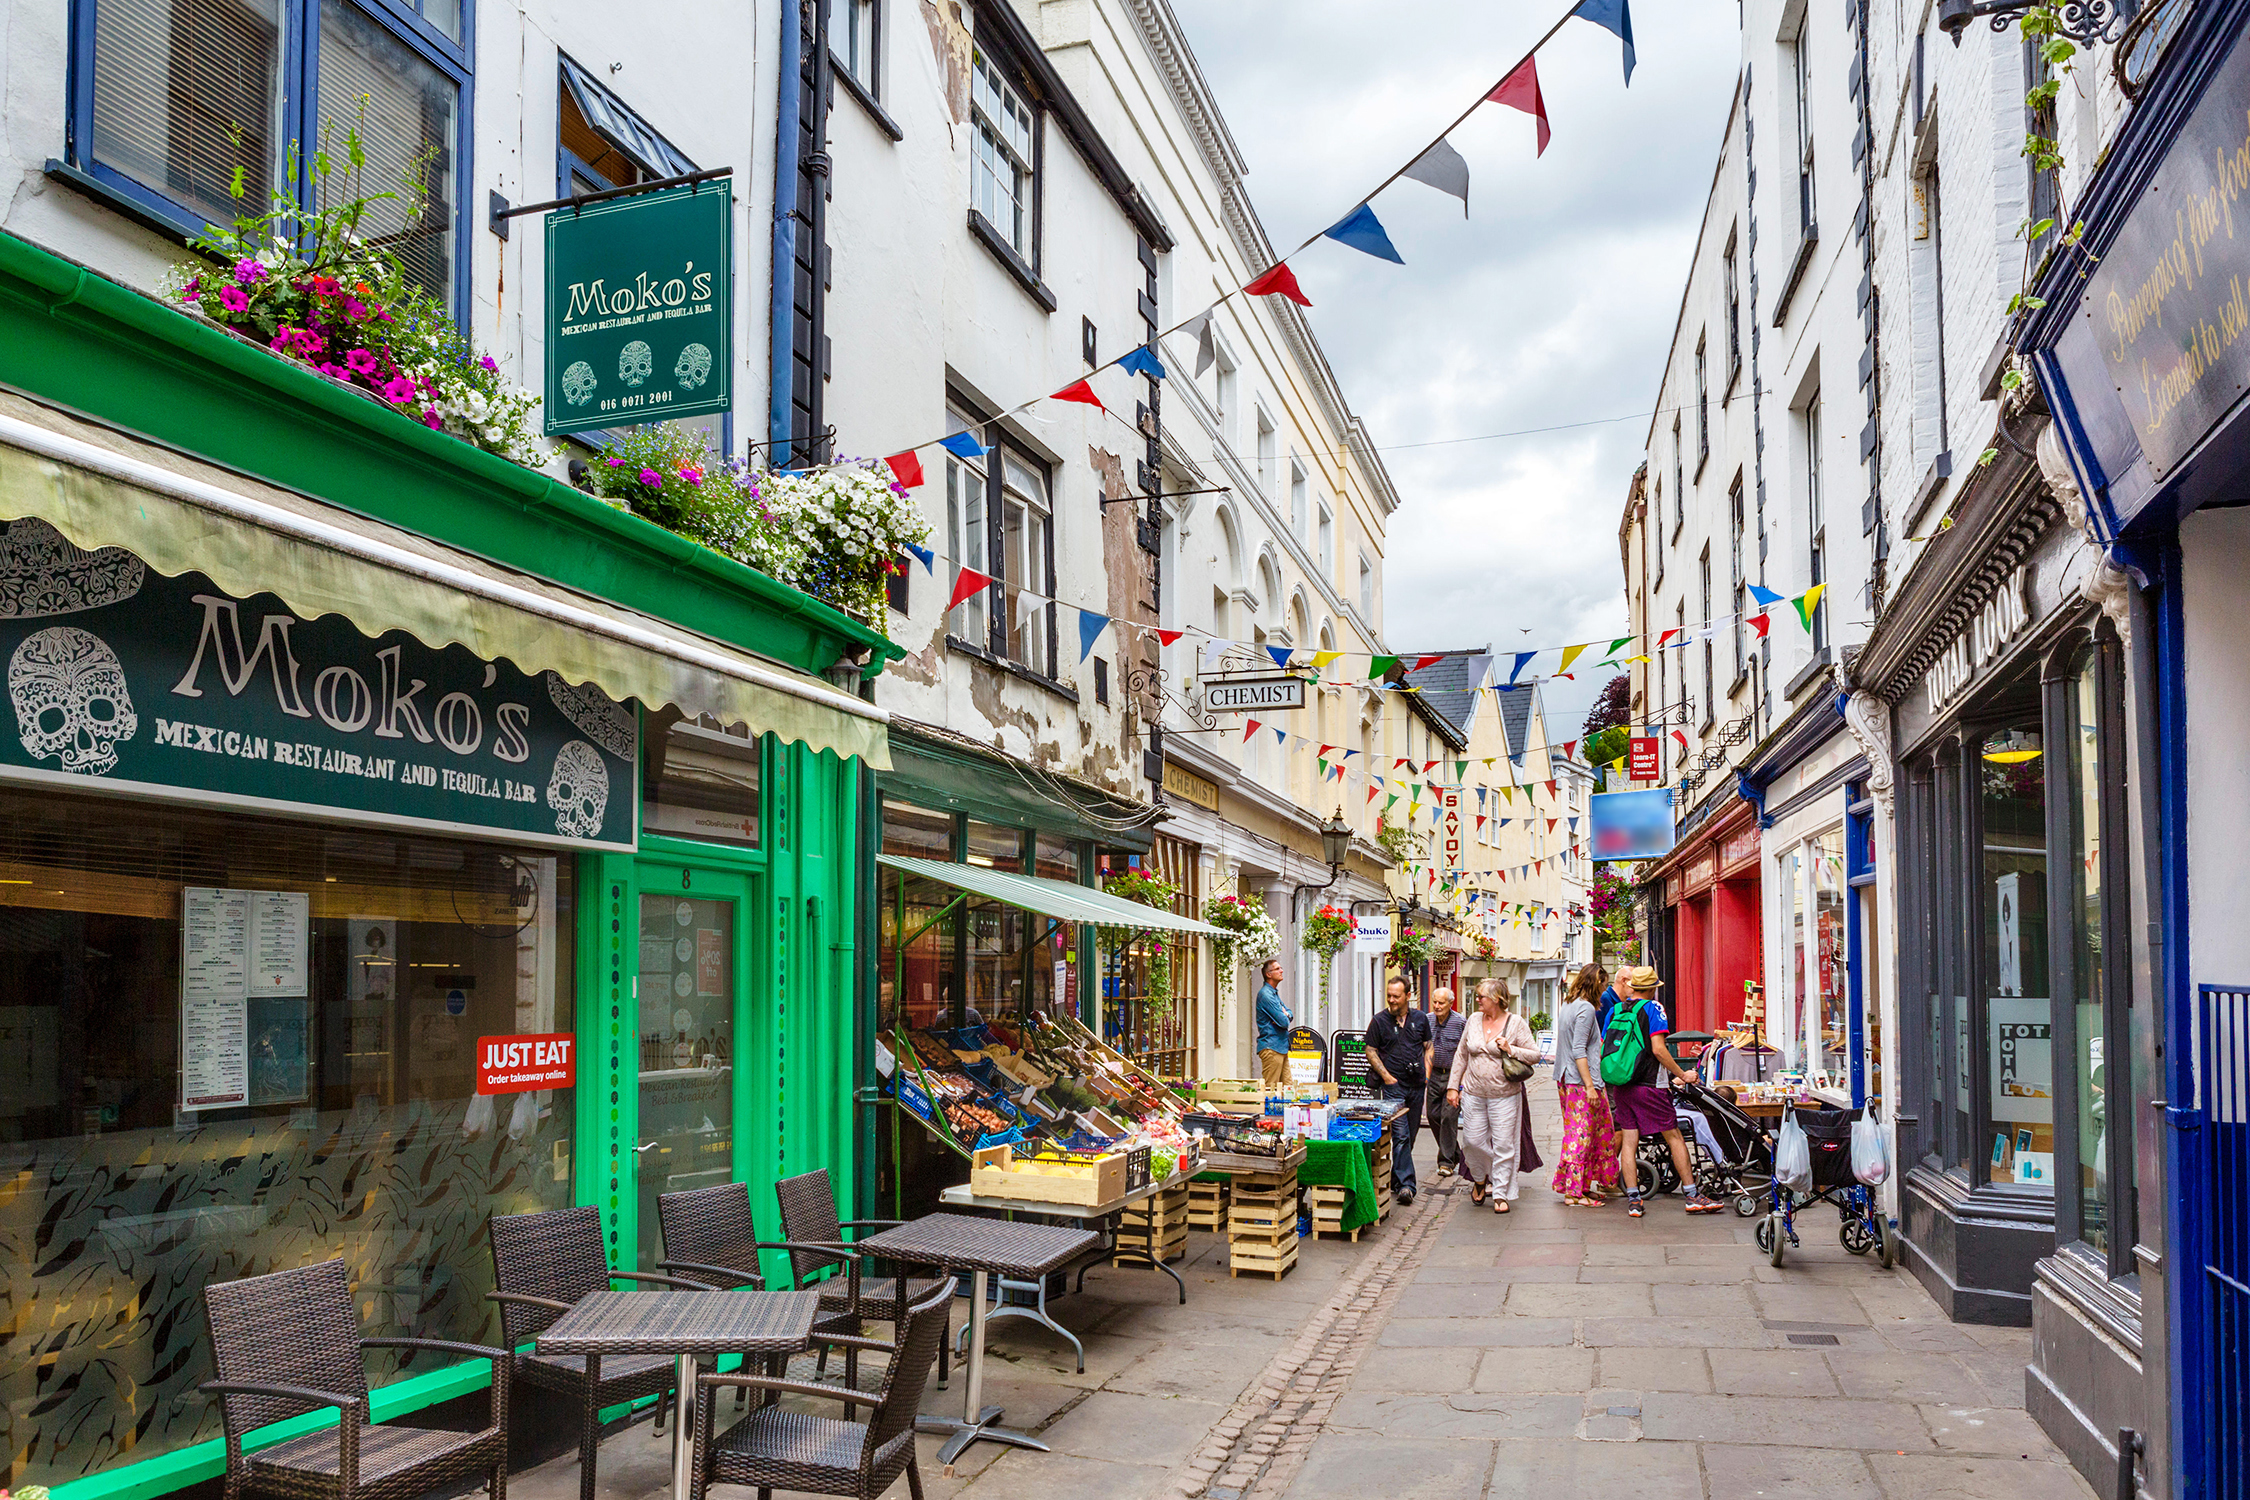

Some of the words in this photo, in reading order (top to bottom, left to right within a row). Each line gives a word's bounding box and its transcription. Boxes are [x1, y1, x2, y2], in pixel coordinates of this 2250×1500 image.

[2106, 247, 2176, 363] Purveyors
[2172, 209, 2192, 291] of
[2187, 185, 2220, 277] fine
[563, 260, 712, 323] Moko's
[561, 322, 598, 337] MEXICAN
[599, 314, 645, 330] RESTAURANT
[647, 311, 663, 322] AND
[665, 306, 693, 319] TEQUILA
[695, 303, 713, 314] BAR
[2141, 327, 2204, 434] Licensed
[2199, 317, 2220, 366] to
[2218, 273, 2248, 351] sell
[600, 398, 617, 411] 016
[621, 394, 644, 408] 0071
[649, 390, 673, 404] 2001
[1925, 633, 1972, 715] TOTAL
[1973, 565, 2029, 668] LOOK
[171, 594, 530, 763] Moko's
[1210, 685, 1296, 706] CHEMIST
[154, 717, 269, 762] MEXICAN
[274, 740, 397, 783] RESTAURANT
[401, 762, 438, 788] AND
[441, 768, 501, 798] TEQUILA
[504, 780, 538, 804] BAR
[1170, 768, 1214, 805] CHEMIST
[1445, 795, 1459, 866] SAVOY
[682, 868, 691, 889] 8
[1357, 927, 1389, 935] ShuKo
[1292, 1037, 1313, 1045] Nights
[482, 1042, 533, 1070] JUST
[535, 1040, 571, 1066] EAT
[1297, 1063, 1319, 1071] Nights
[487, 1074, 509, 1085] Order
[510, 1072, 544, 1082] takeaway
[545, 1069, 567, 1080] online
[639, 1082, 678, 1093] Mexican
[1341, 1075, 1355, 1083] Thai
[652, 1093, 668, 1106] Bed
